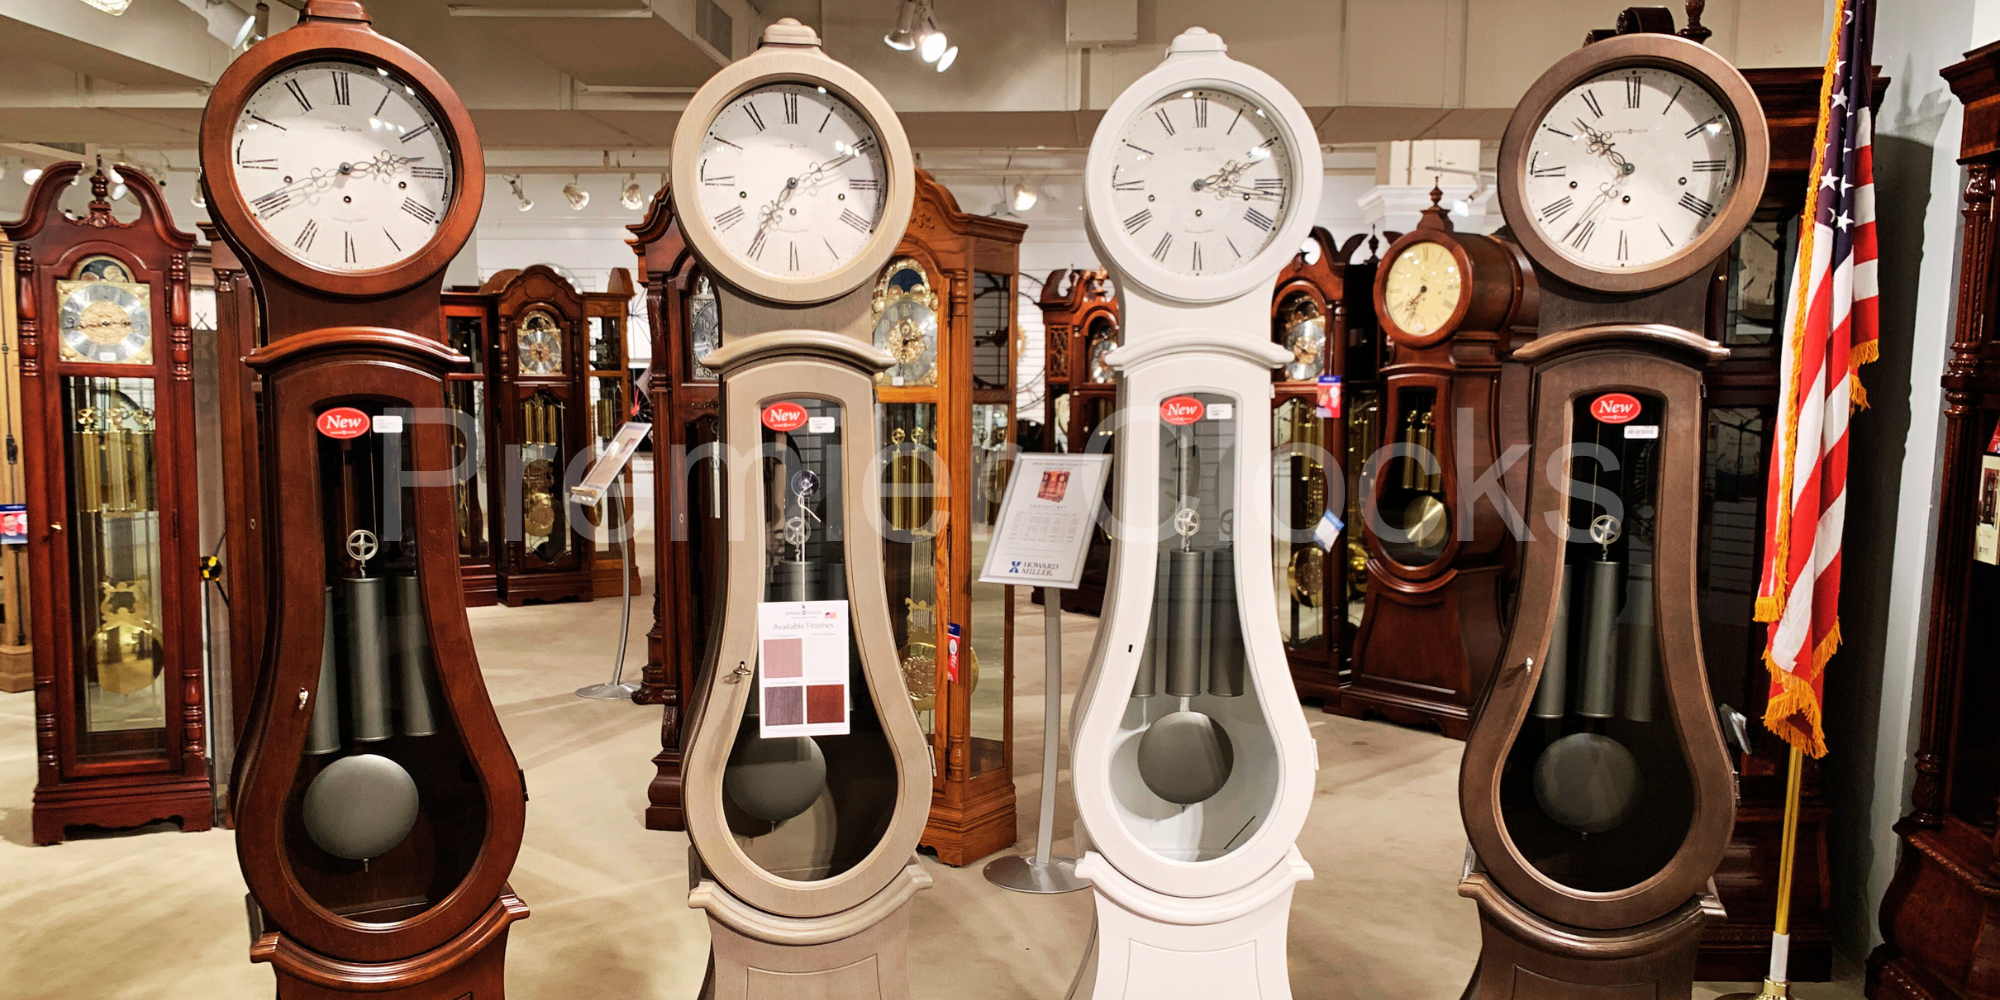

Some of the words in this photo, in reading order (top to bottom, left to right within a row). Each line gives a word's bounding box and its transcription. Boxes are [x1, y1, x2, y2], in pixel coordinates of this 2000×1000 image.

[284, 78, 315, 115] XI
[332, 72, 351, 106] XII
[1622, 76, 1642, 110] XII
[743, 101, 767, 135] XI
[782, 93, 799, 125] XII
[1191, 98, 1208, 128] XII
[1581, 89, 1606, 122] XI
[251, 110, 287, 135] X
[399, 124, 431, 143] II
[1155, 107, 1176, 139] XI
[714, 132, 744, 156] X
[1126, 139, 1154, 159] X
[242, 156, 278, 170] IX
[411, 166, 444, 179] III
[1534, 165, 1566, 178] IX
[1692, 160, 1727, 172] III
[705, 175, 735, 186] IX
[849, 179, 878, 190] III
[1114, 179, 1144, 191] IX
[401, 197, 436, 224] IIII
[1678, 191, 1714, 219] IIII
[839, 207, 871, 234] IIII
[1243, 206, 1274, 232] IIII
[294, 219, 320, 252] VII
[344, 230, 356, 263] VI
[382, 225, 402, 252] V
[1152, 232, 1174, 263] VII
[1226, 235, 1242, 259] V
[1617, 230, 1629, 260] VI
[1657, 222, 1674, 247] V
[789, 241, 799, 271] VI
[822, 235, 839, 261] V
[1192, 241, 1202, 271] VI
[770, 408, 800, 422] New
[1167, 402, 1197, 416] New
[1599, 400, 1633, 413] New
[326, 414, 361, 428] New
[1023, 561, 1059, 570] HOWARD
